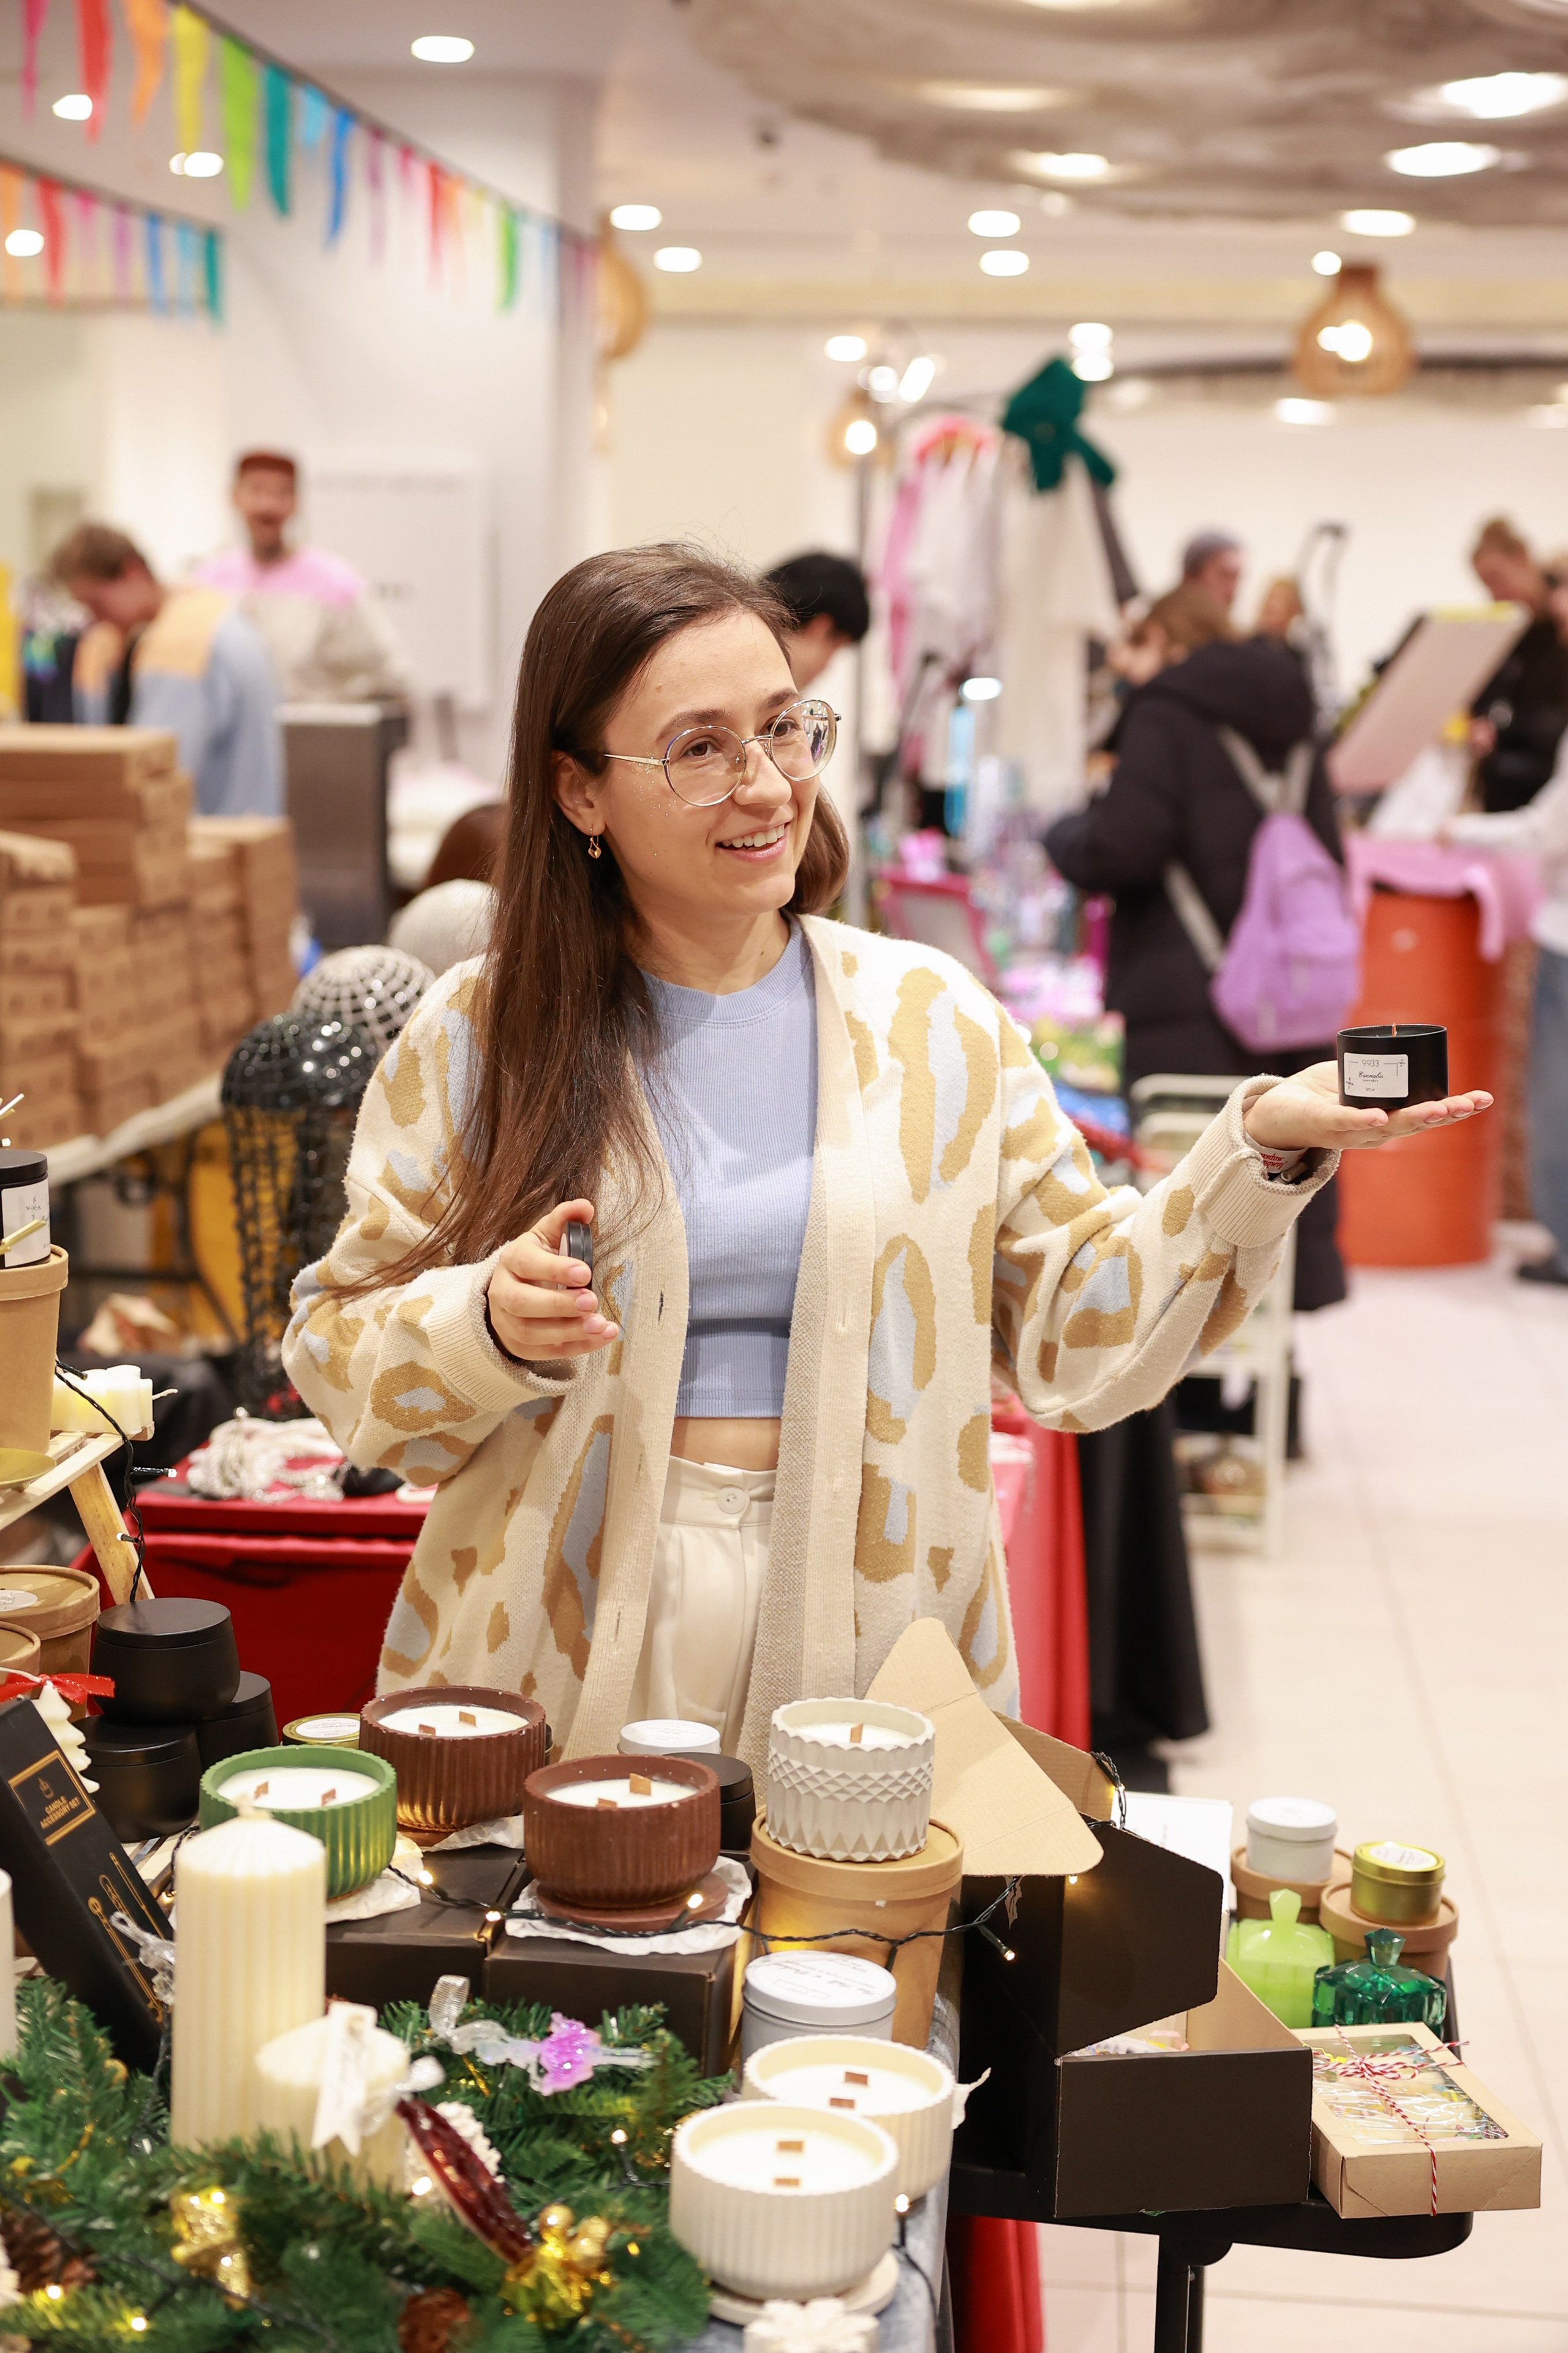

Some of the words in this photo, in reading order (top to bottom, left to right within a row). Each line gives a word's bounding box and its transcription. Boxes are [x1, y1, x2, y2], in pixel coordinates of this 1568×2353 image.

[1259, 1152, 1284, 1161] марке
[40, 1803, 70, 1830] ACCESSORY
[69, 1797, 80, 1809] SET
[45, 1796, 67, 1815] CANDLE
